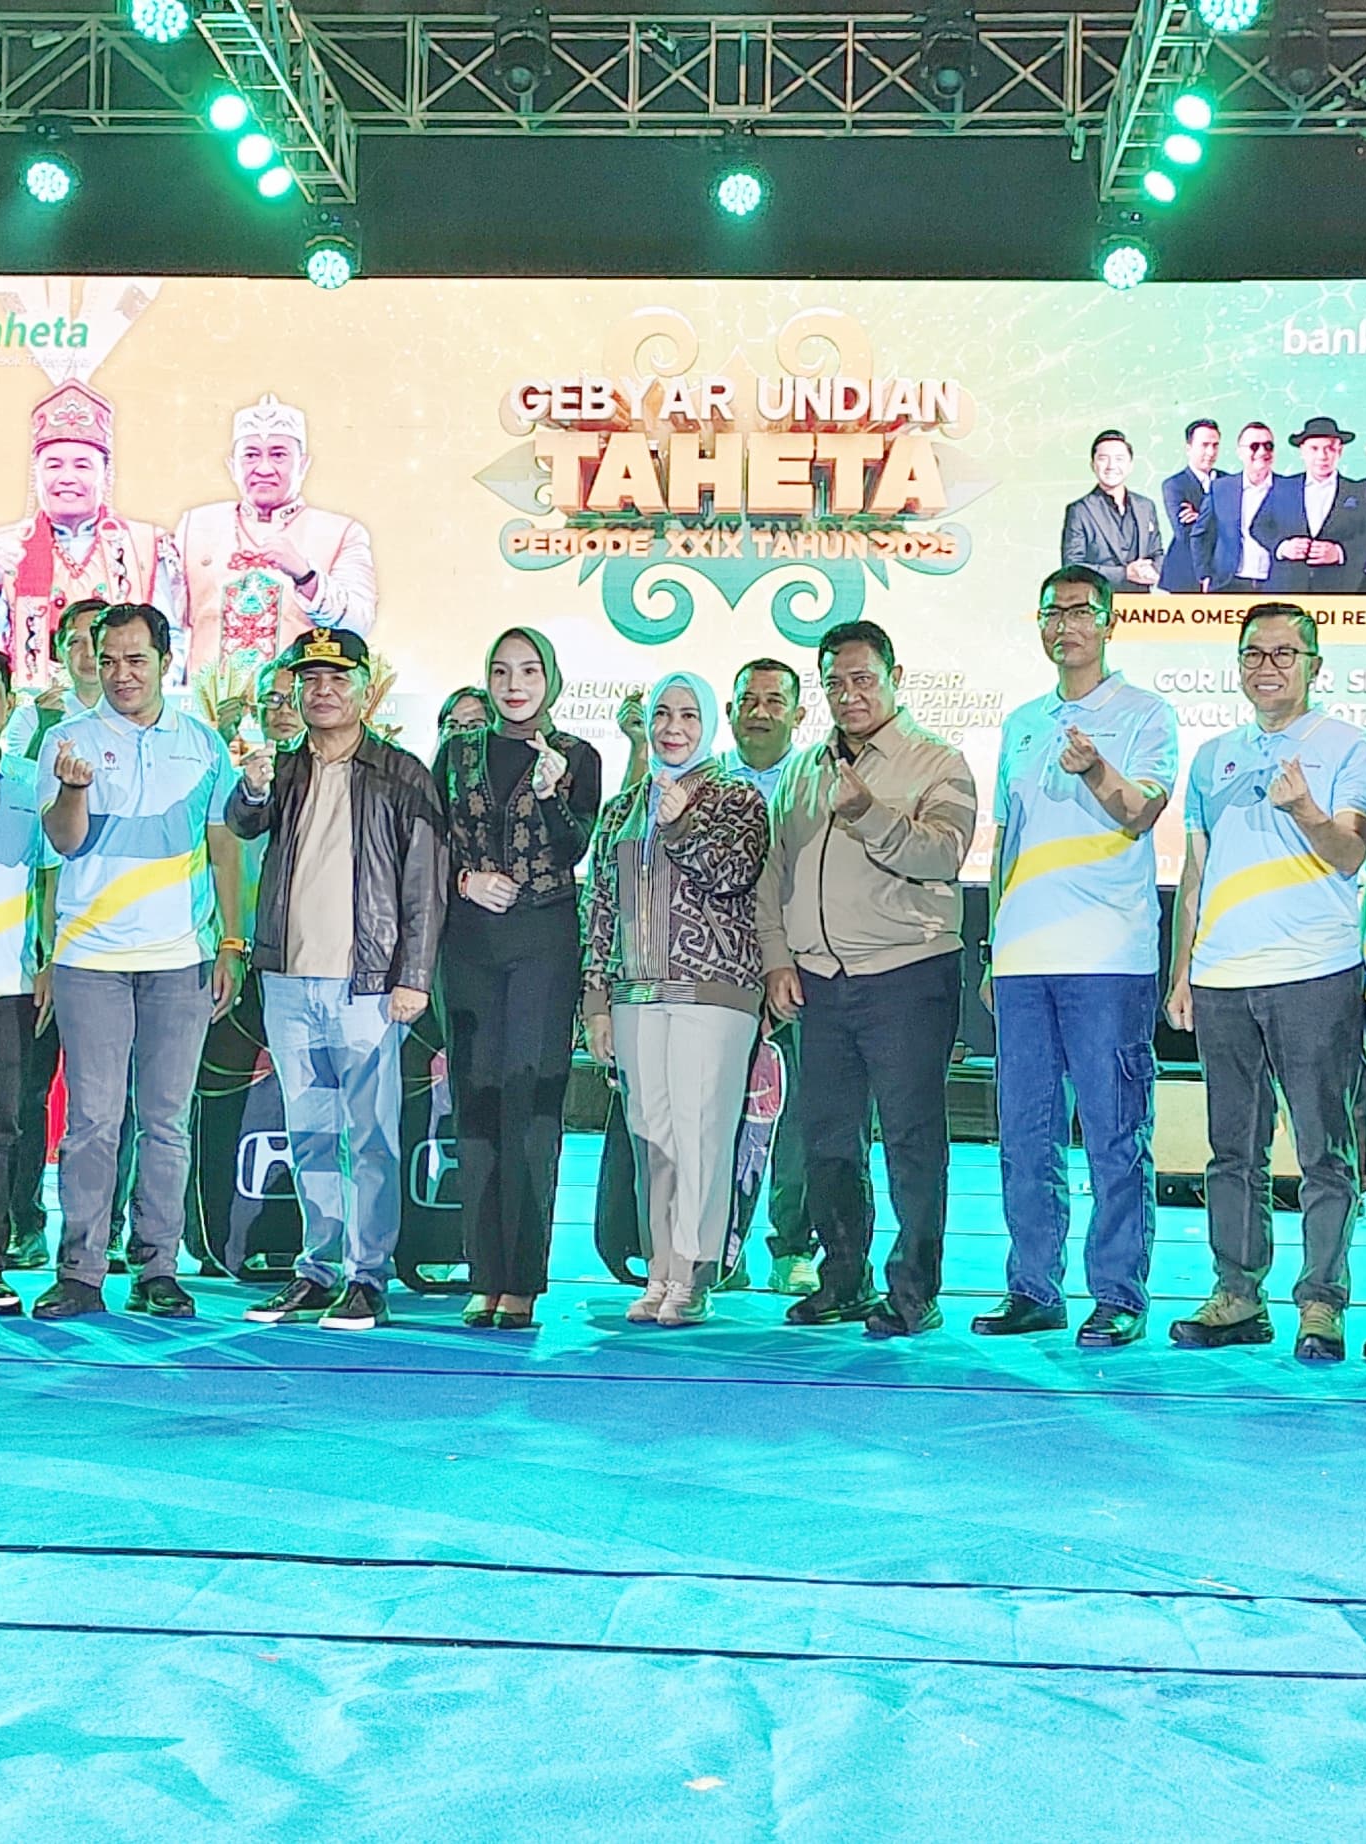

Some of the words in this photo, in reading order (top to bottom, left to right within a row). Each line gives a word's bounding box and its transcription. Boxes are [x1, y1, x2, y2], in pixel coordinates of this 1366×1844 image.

[509, 375, 735, 422] GEBYAR
[755, 376, 961, 425] UNDIAN
[534, 431, 949, 517] TAHETA
[507, 530, 655, 559] PERIODE
[664, 531, 744, 560] XXIX
[752, 532, 868, 561] TAHUN
[873, 533, 960, 562] 2025
[1114, 608, 1186, 625] NANDA
[1191, 609, 1246, 625] OMES
[1154, 668, 1217, 693] GOR
[923, 691, 1003, 709] PAHARI
